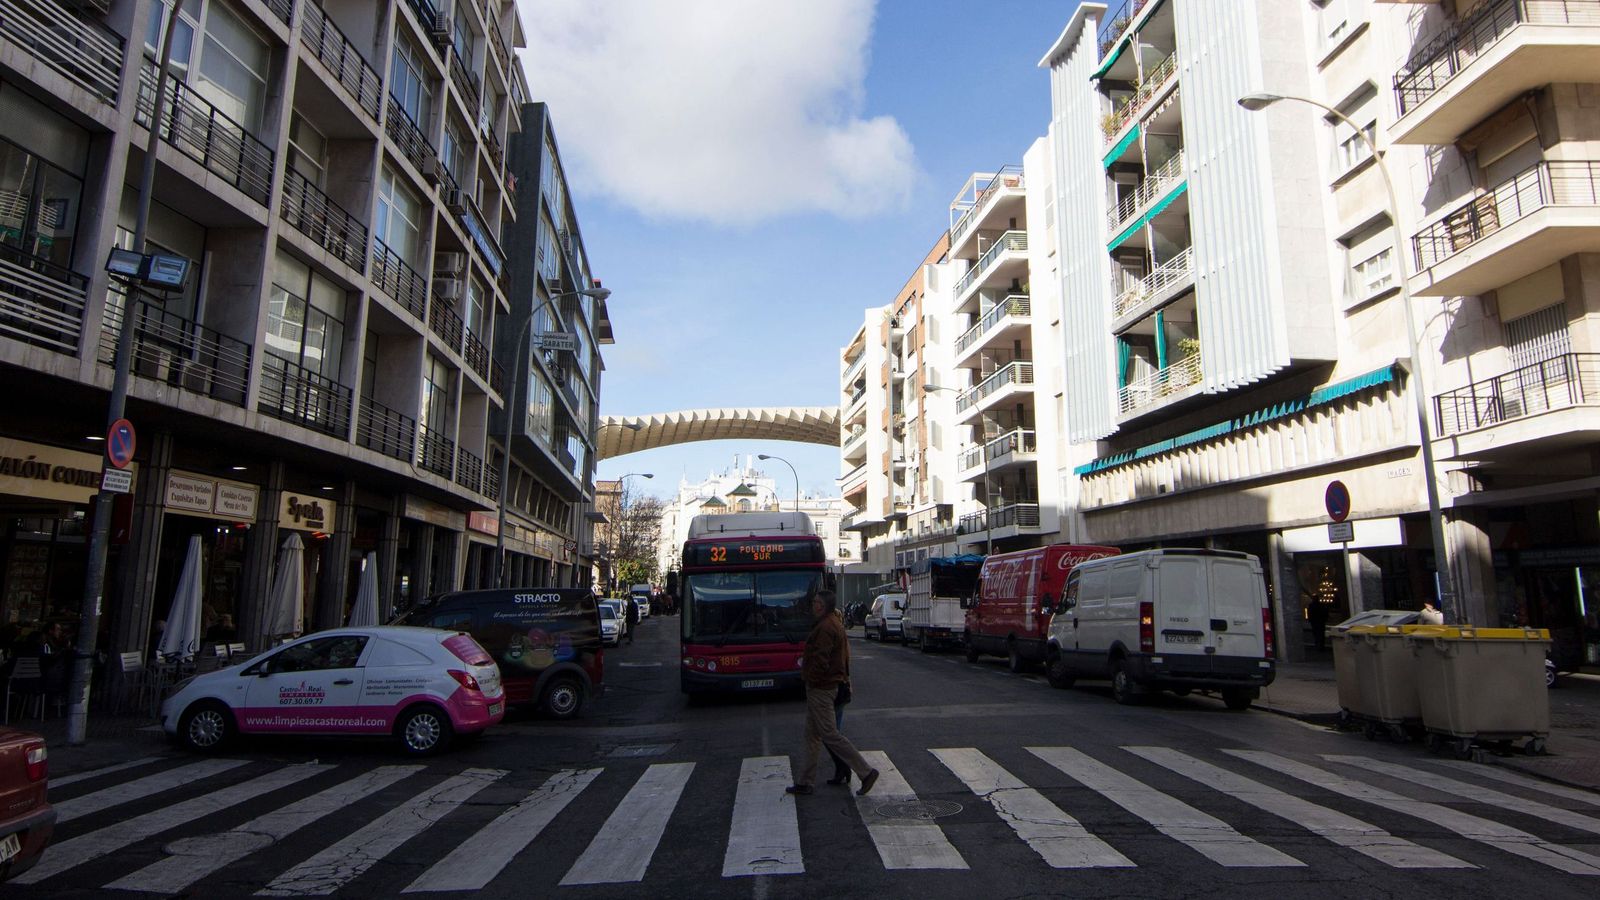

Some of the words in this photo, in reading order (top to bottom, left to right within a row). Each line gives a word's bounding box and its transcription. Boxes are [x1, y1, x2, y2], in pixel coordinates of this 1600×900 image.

[544, 340, 573, 348] SABATER
[0, 456, 51, 480] ALÓN
[710, 546, 727, 561] 32
[739, 544, 784, 553] POLIGONO
[754, 552, 771, 560] SUR
[1058, 552, 1112, 570] Coca-C
[514, 593, 561, 603] STRACTO
[720, 656, 740, 666] 1815
[246, 716, 386, 727] www.limpiezacastroreal.com
